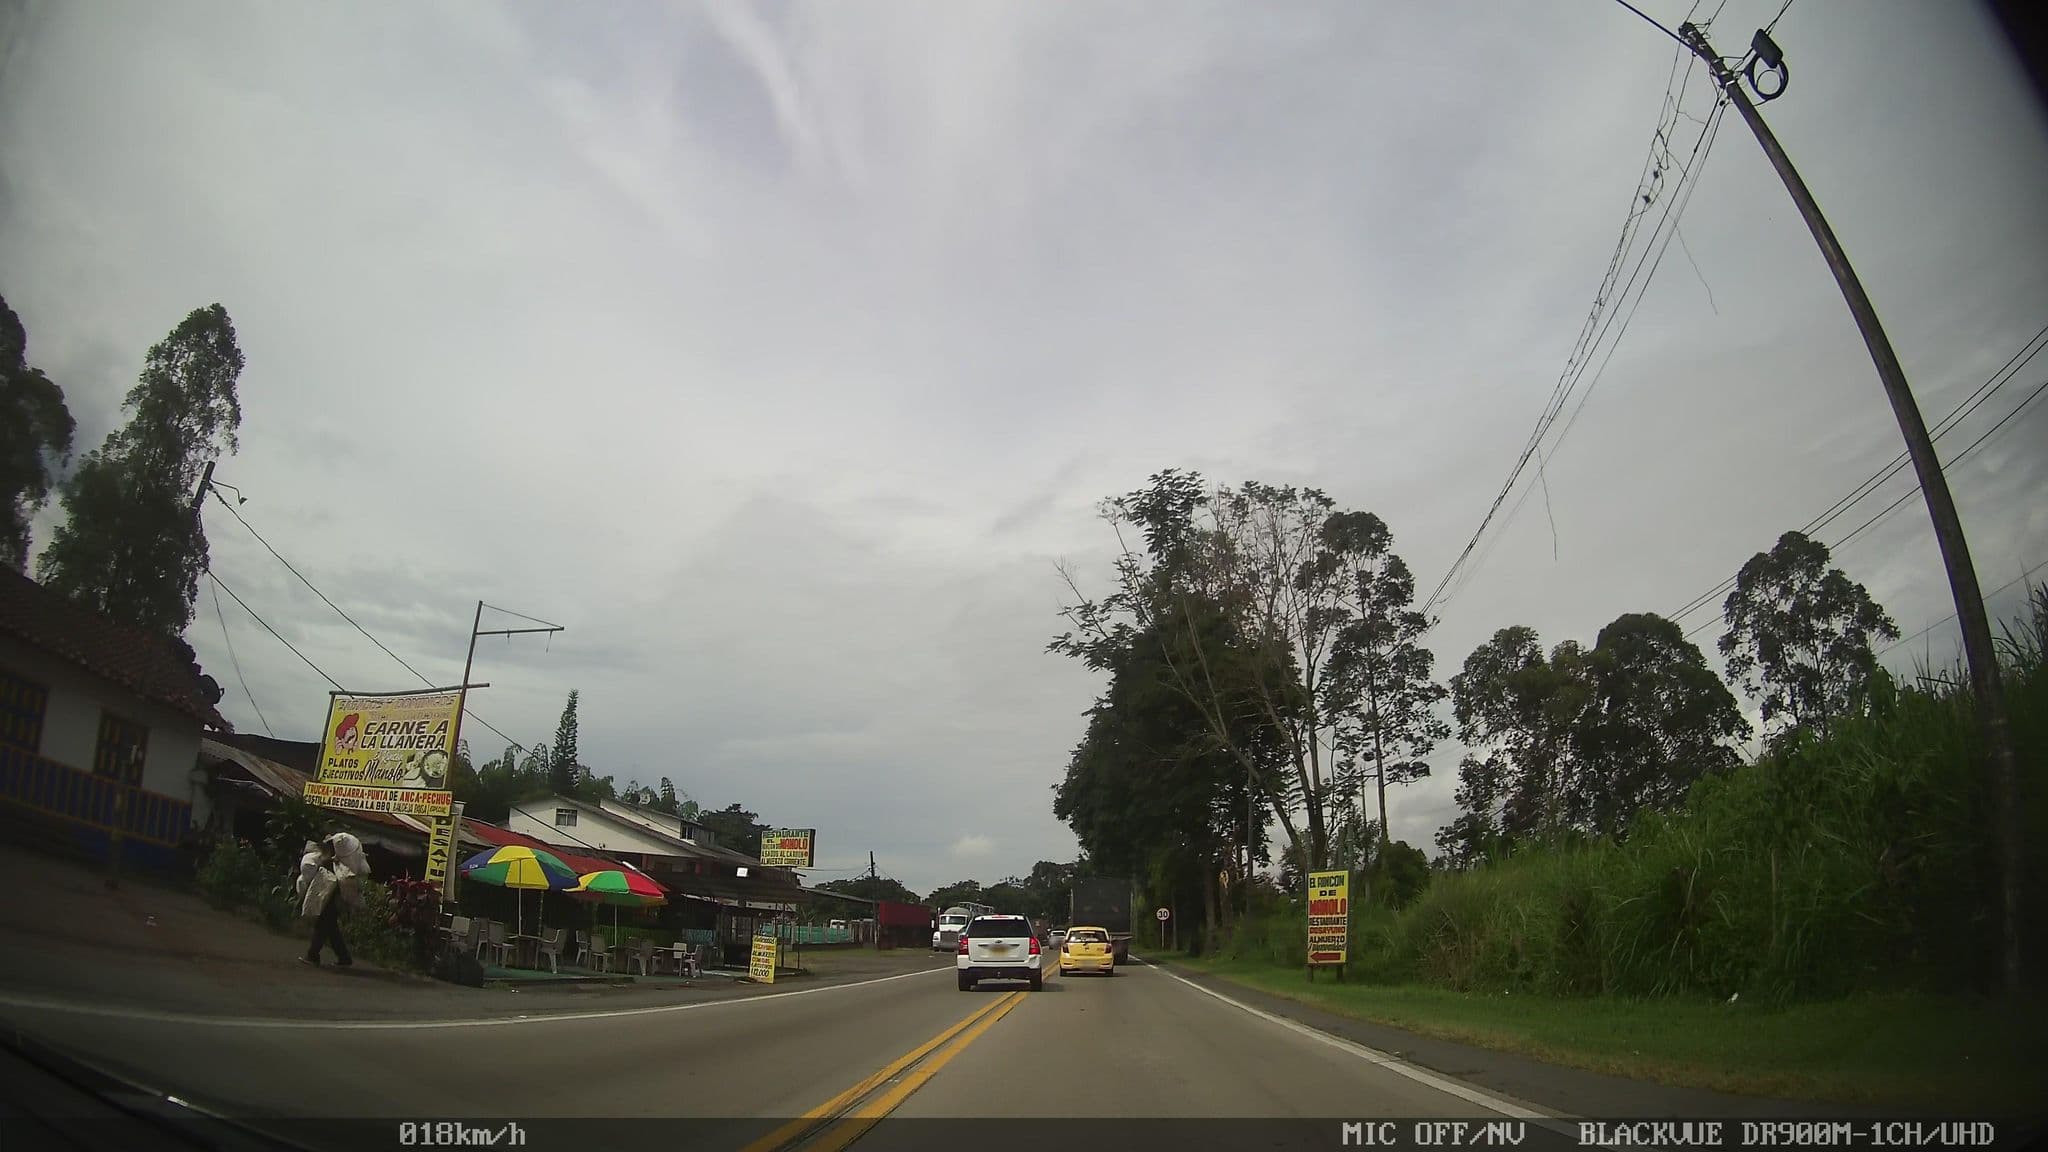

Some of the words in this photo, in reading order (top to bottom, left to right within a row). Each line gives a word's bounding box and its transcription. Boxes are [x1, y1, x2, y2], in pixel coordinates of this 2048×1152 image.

[364, 720, 430, 735] CARNE
[431, 719, 449, 735] A
[360, 736, 379, 749] LA
[380, 734, 446, 749] LLANERA
[328, 757, 359, 768] PLATOS
[322, 768, 364, 780] EJECUTIVOS
[389, 790, 398, 802] DE
[376, 801, 391, 812] BBQ
[1319, 889, 1337, 897] DE
[1309, 935, 1346, 944] ALMUERZO
